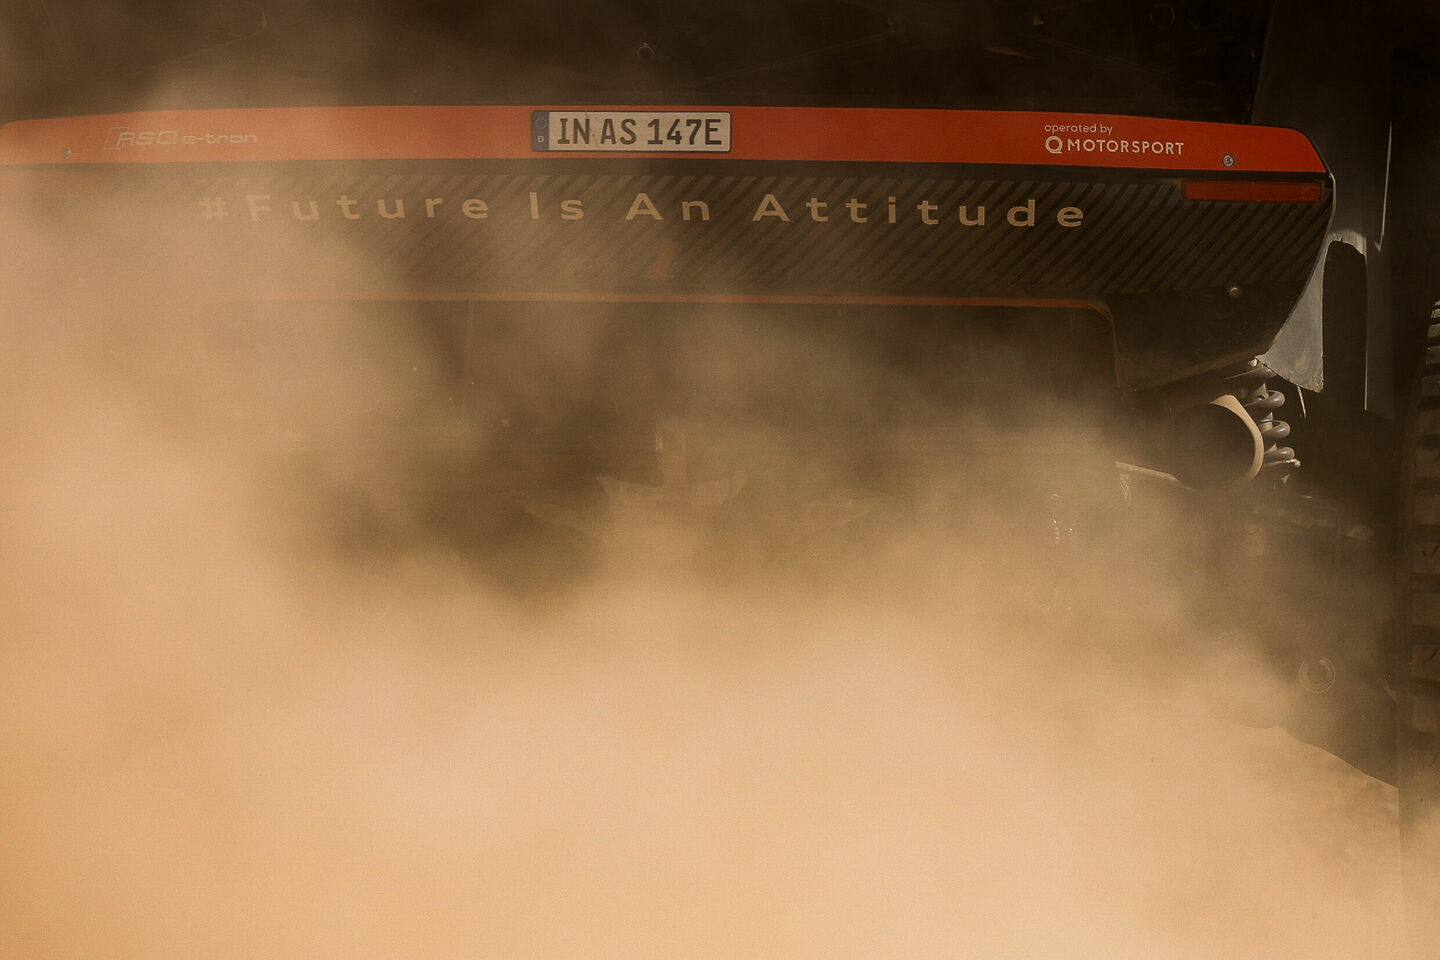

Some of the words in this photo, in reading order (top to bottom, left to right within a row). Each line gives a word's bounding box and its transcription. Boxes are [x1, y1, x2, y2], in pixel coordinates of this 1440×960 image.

[557, 117, 591, 145] IN
[600, 118, 638, 145] AS
[647, 118, 722, 145] 147E
[1044, 123, 1097, 134] operated
[1100, 124, 1113, 136] by
[530, 190, 585, 221] Is
[625, 190, 711, 222] An
[752, 192, 1086, 229] Attitude
